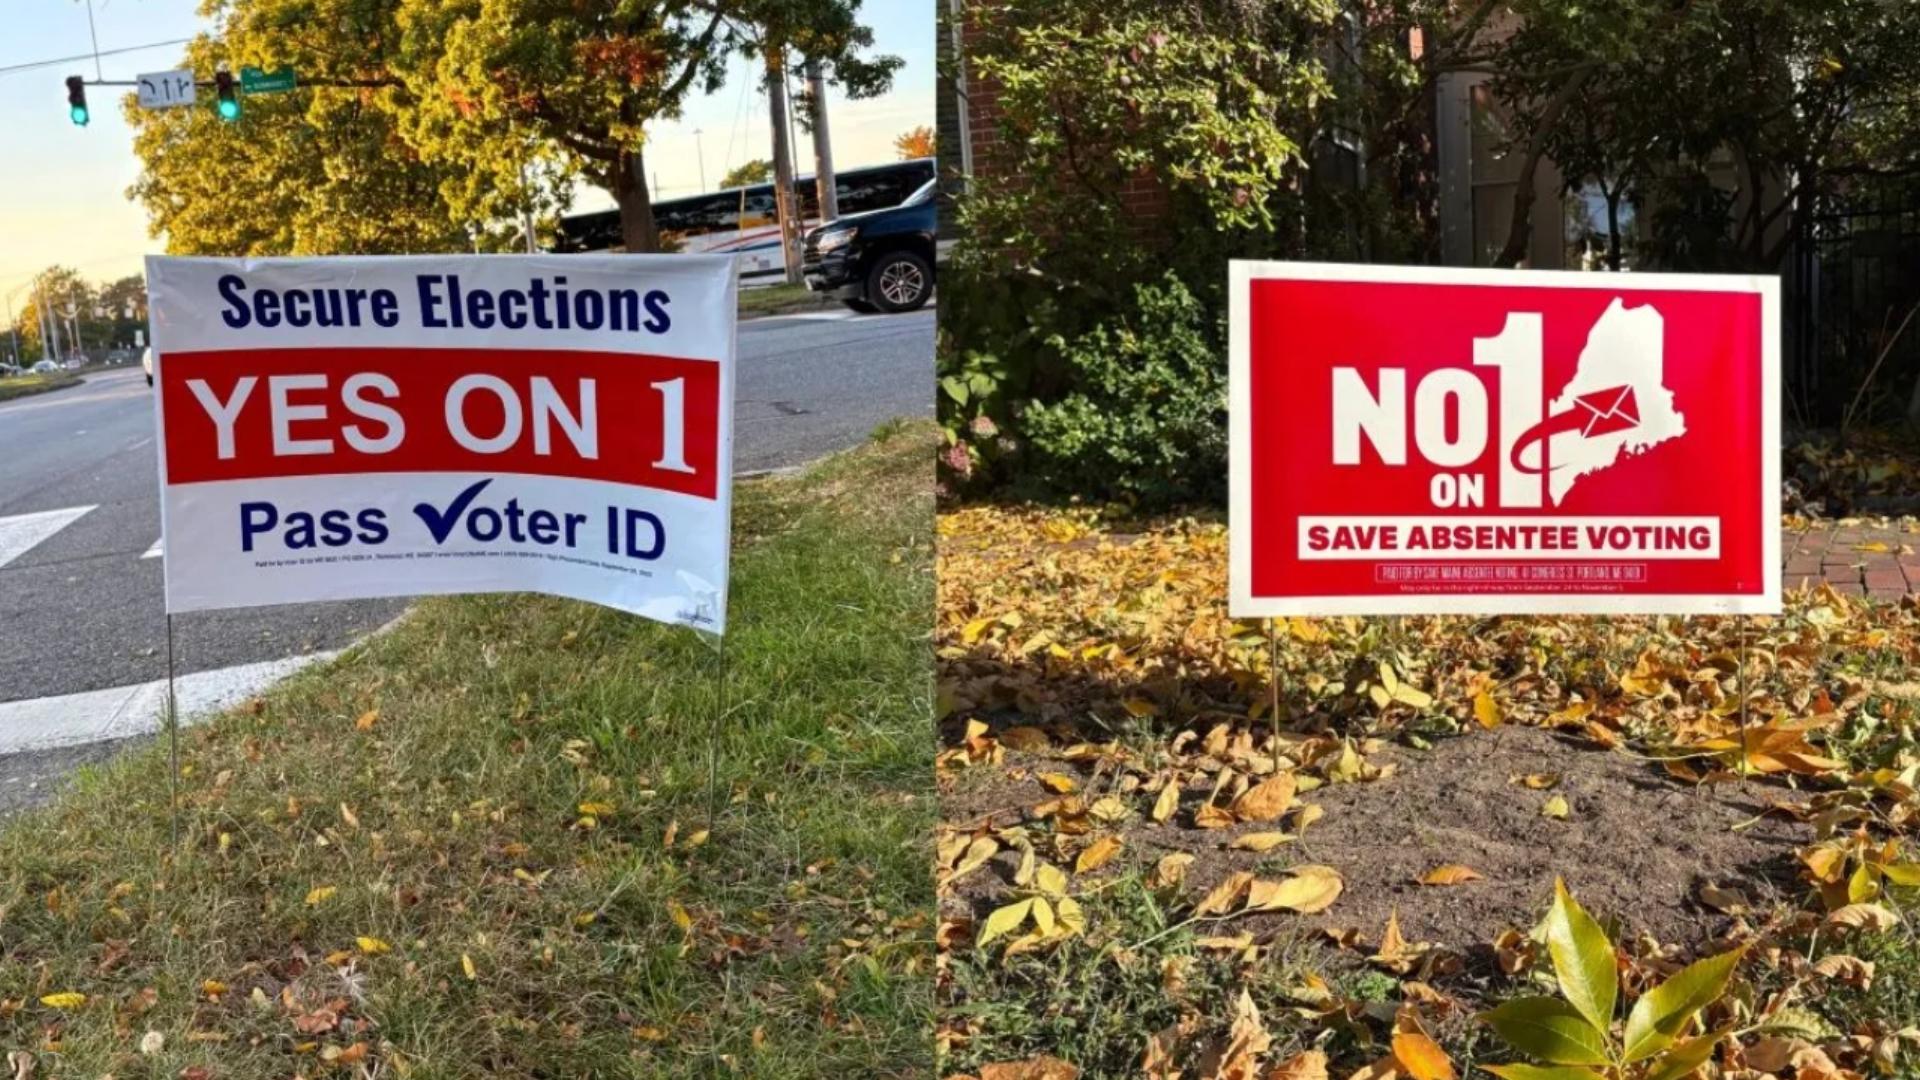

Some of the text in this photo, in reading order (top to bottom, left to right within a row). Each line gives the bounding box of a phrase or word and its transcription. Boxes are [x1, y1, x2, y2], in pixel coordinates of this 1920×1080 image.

[218, 274, 670, 334] Secure Elections
[186, 373, 695, 473] YES ON 1
[1332, 367, 1488, 467] NO
[1473, 312, 1543, 508] 1
[1431, 473, 1484, 507] ON
[241, 502, 388, 552] Pass
[608, 506, 665, 560] ID
[1309, 526, 1710, 550] SAVE ABSENTEE VOTING
